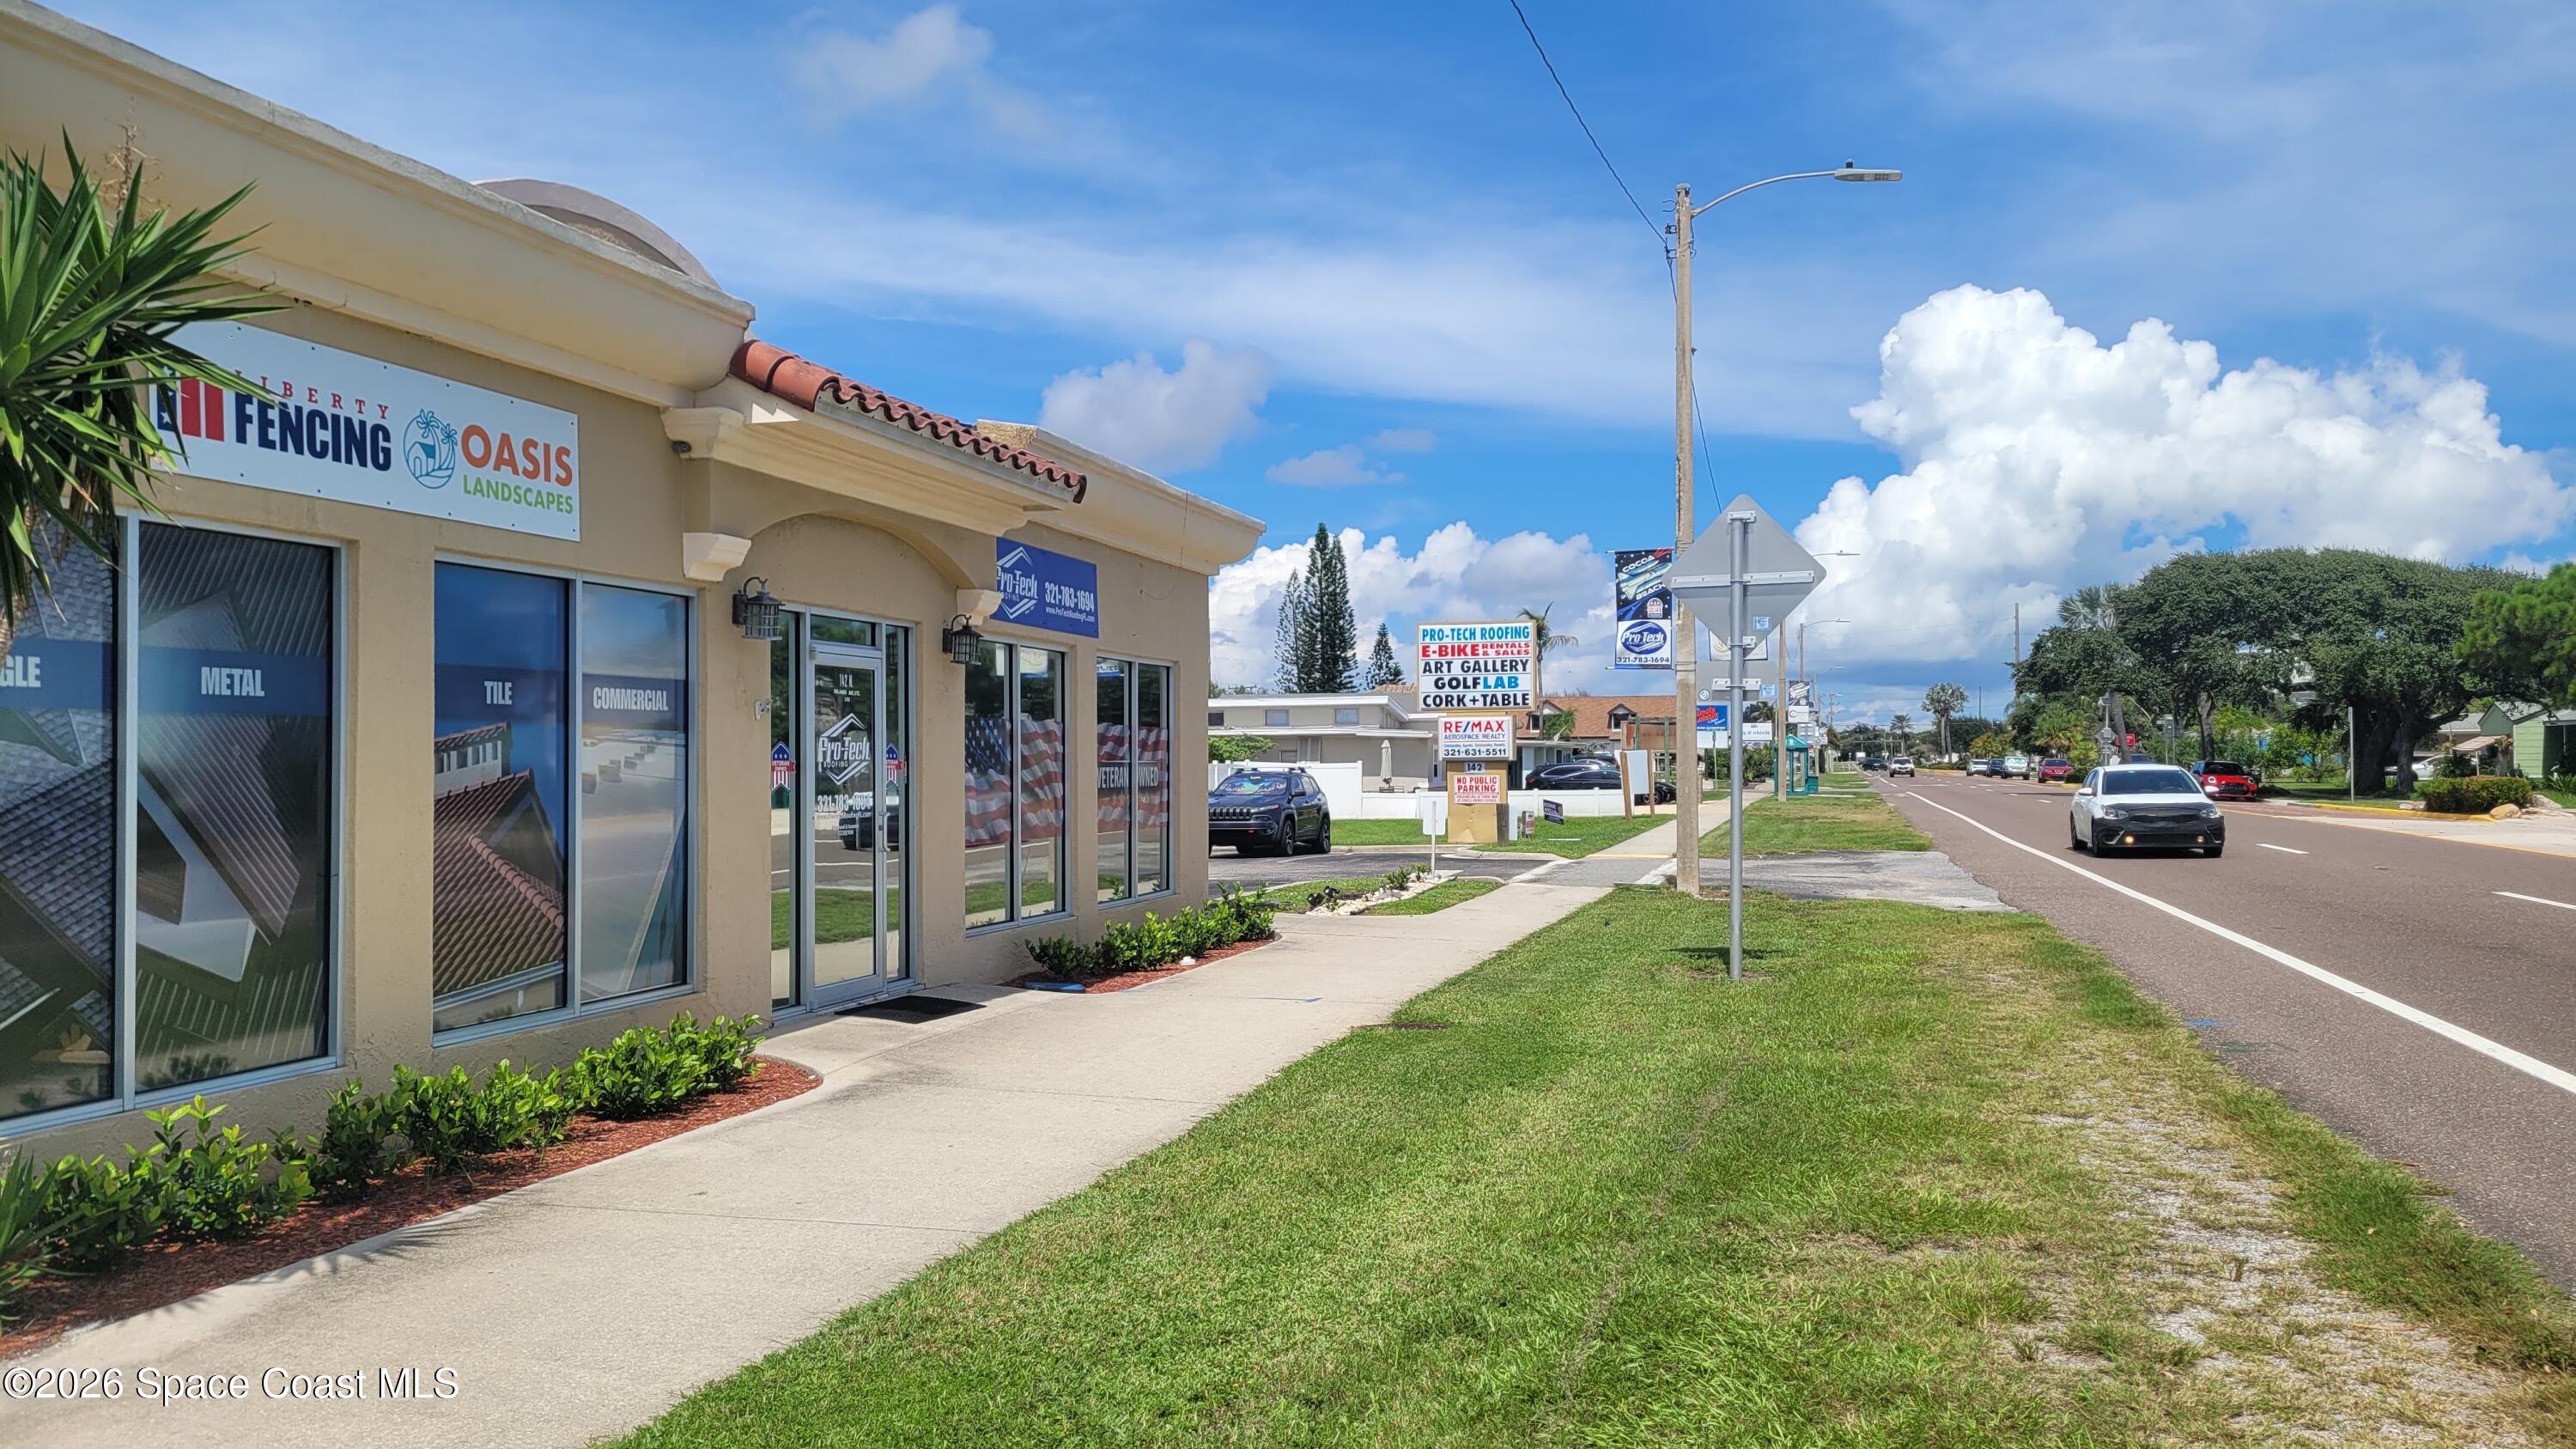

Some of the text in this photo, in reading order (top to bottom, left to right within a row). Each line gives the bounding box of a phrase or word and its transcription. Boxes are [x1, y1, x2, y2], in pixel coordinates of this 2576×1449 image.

[234, 369, 389, 419] IBERTY
[234, 390, 392, 472] FENCING
[460, 424, 573, 487] OASIS
[463, 474, 574, 514] LANDSCAPES
[1622, 555, 1656, 573] COCOA
[1045, 581, 1095, 612] 321-783-1694
[1636, 583, 1666, 600] BEACH
[1422, 626, 1529, 642] PRO-TECH ROOFING
[1422, 643, 1479, 658] E-BIKE
[1422, 659, 1529, 674] ART GALLERY
[201, 667, 264, 697] METAL
[839, 673, 848, 687] 142
[483, 681, 513, 705] TILE
[592, 687, 668, 710] COMMERCIAL
[1443, 721, 1504, 733] RE/MAX
[817, 737, 872, 771] Pro-Tech
[1097, 766, 1158, 788] VETERAN WNED
[1467, 763, 1483, 771] 142
